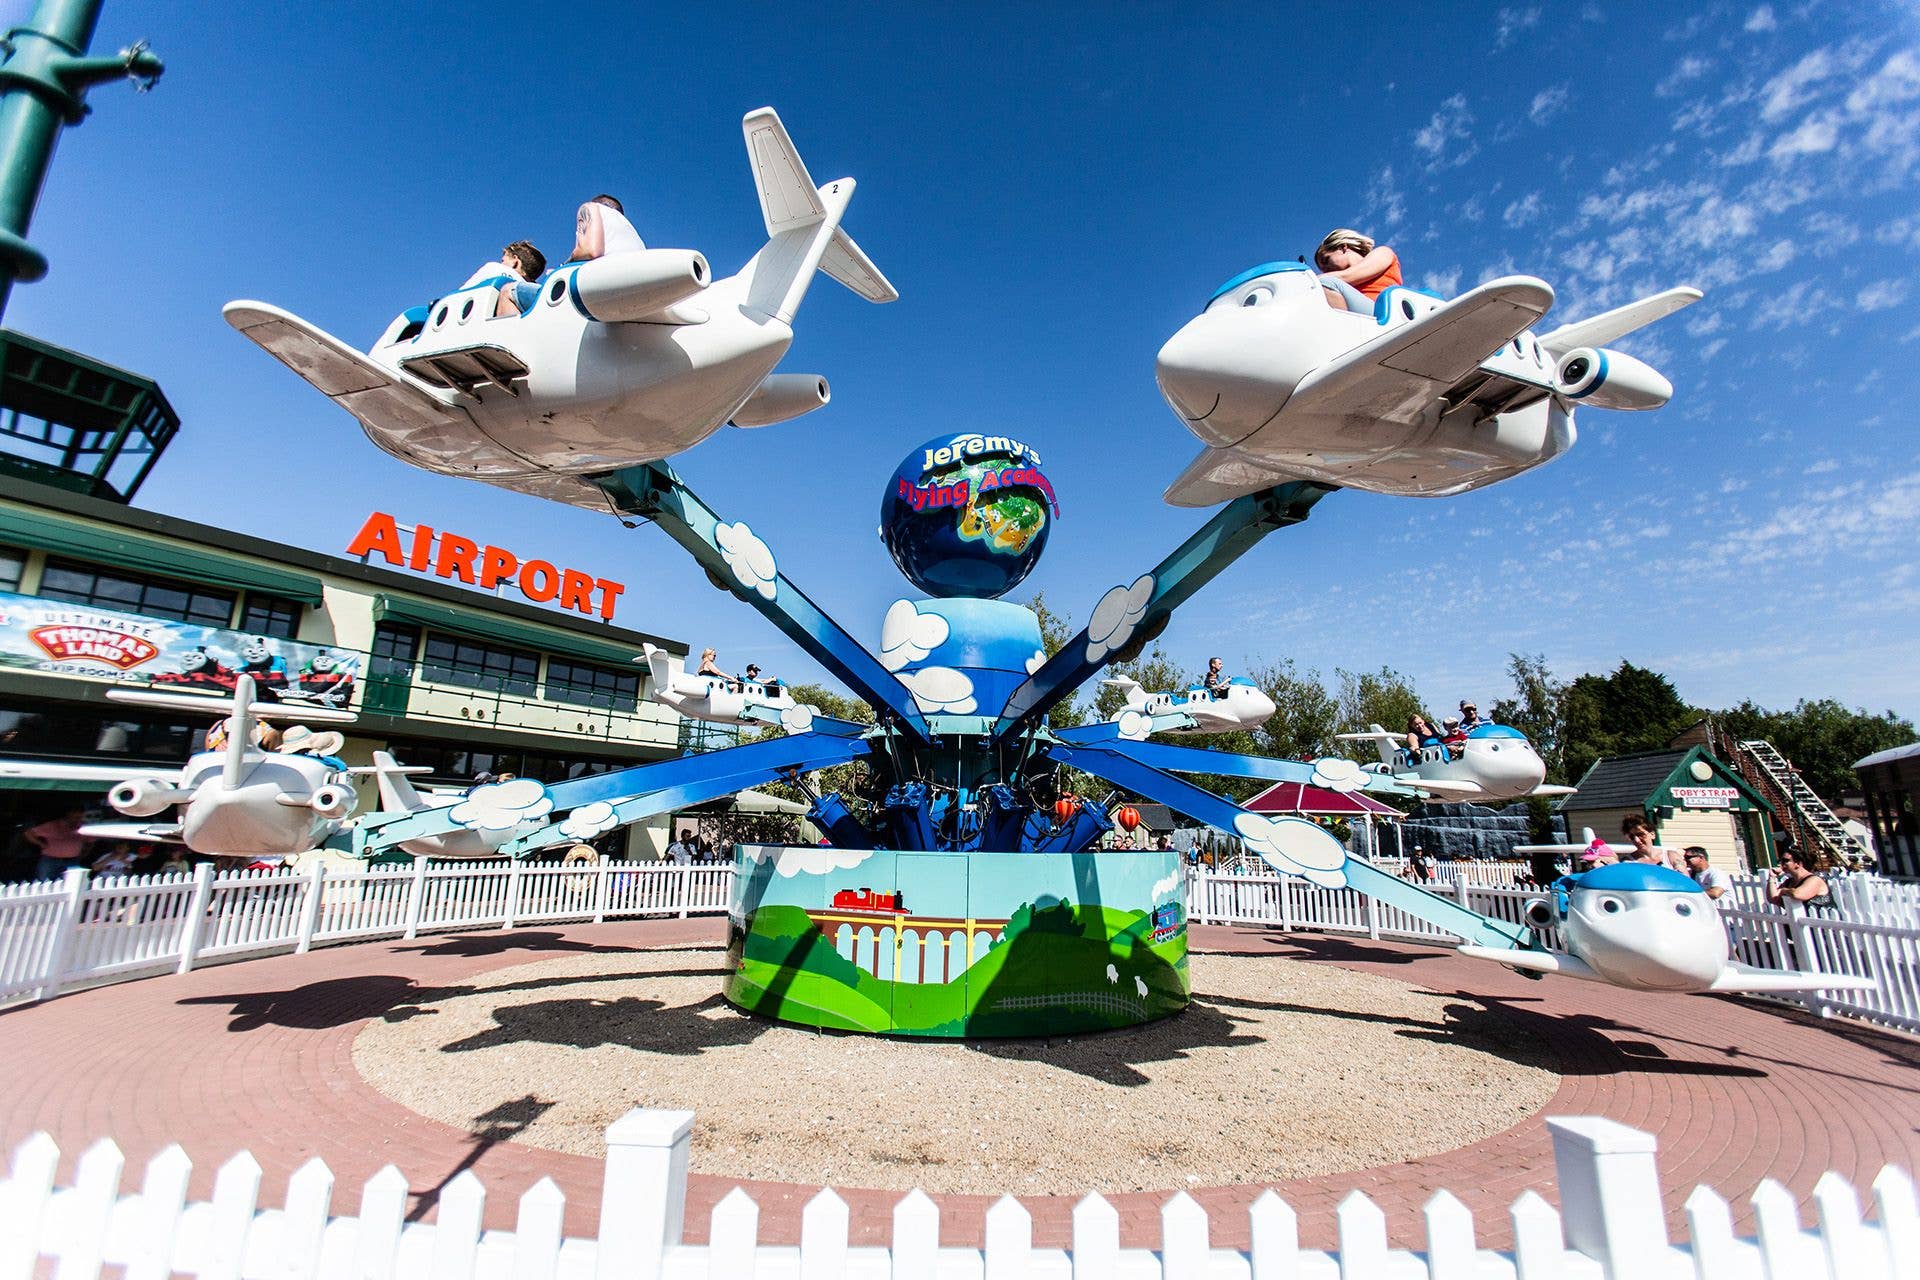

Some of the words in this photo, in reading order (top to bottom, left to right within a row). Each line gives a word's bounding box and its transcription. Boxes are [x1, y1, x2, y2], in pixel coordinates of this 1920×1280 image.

[832, 184, 839, 194] 2
[922, 436, 1042, 471] Jeremy's
[899, 479, 970, 512] Flying
[977, 466, 1060, 520] Acade
[345, 511, 625, 620] AIRPORT
[45, 613, 152, 638] ULTIMATE
[38, 628, 151, 658] THOMAS
[65, 642, 123, 661] LAND
[78, 667, 126, 680] ROOMS
[1673, 789, 1706, 797] TOBY'S
[1707, 789, 1737, 797] TRAM
